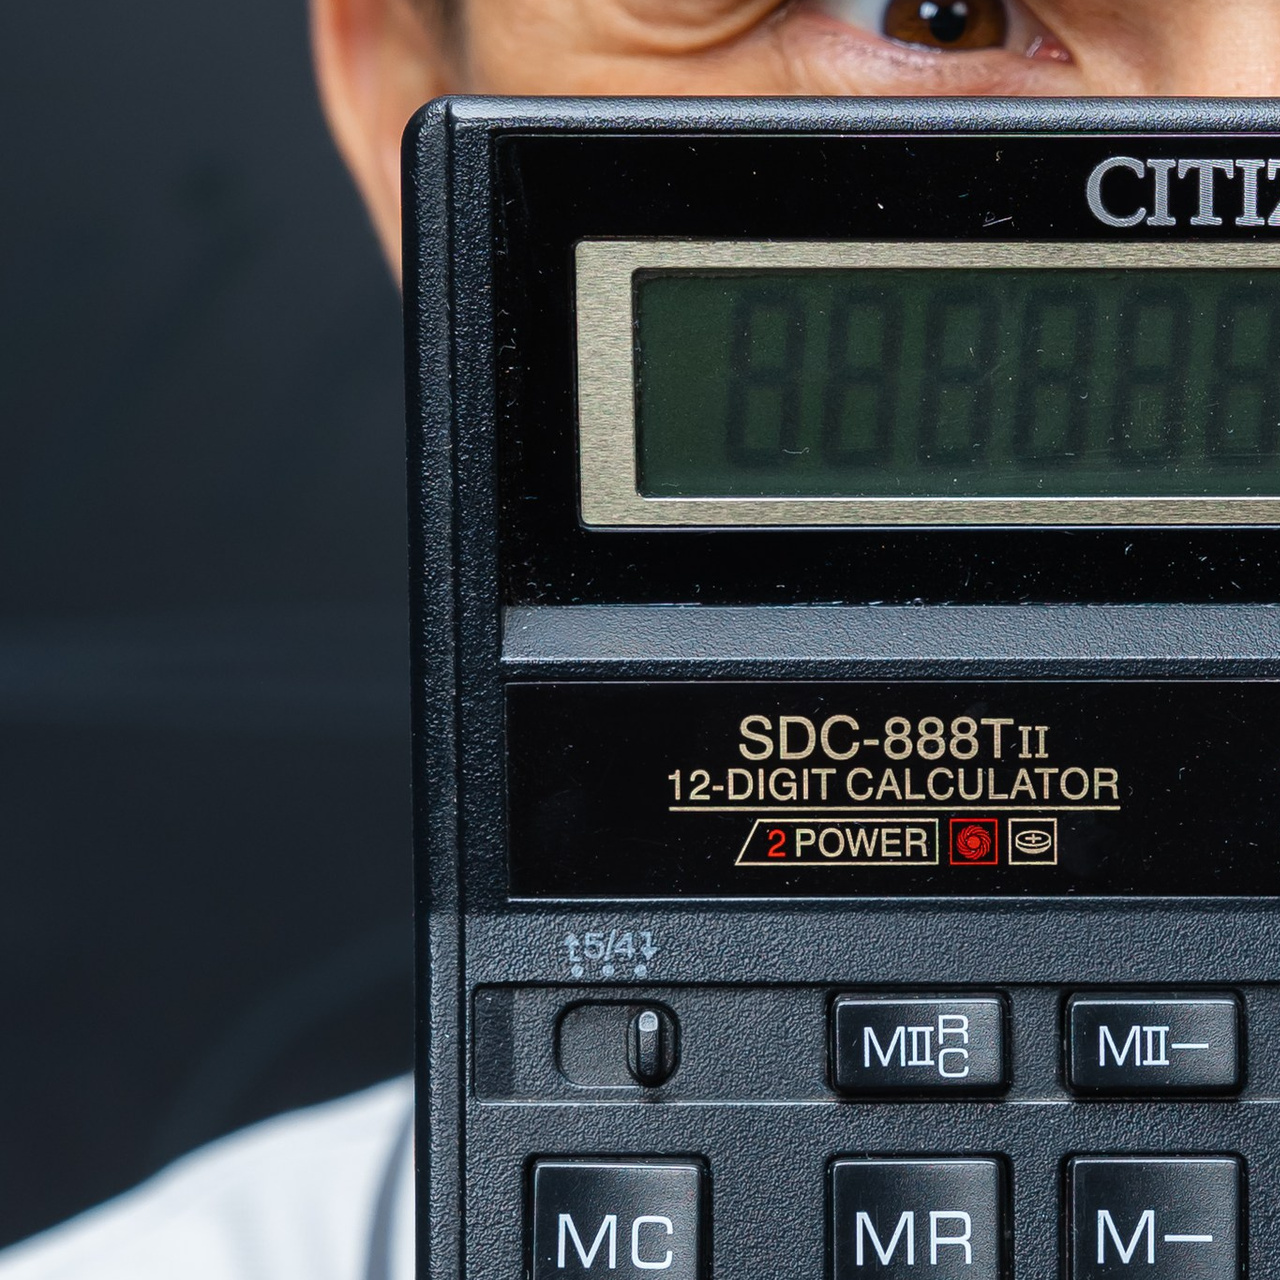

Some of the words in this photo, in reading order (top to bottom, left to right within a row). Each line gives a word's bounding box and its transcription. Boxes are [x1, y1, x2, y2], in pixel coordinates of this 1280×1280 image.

[668, 767, 837, 801] 12-DIGIT
[846, 767, 1119, 801] CALCULATOR
[795, 827, 928, 858] POWER
[556, 1213, 675, 1270] MC
[855, 1209, 972, 1266] MR
